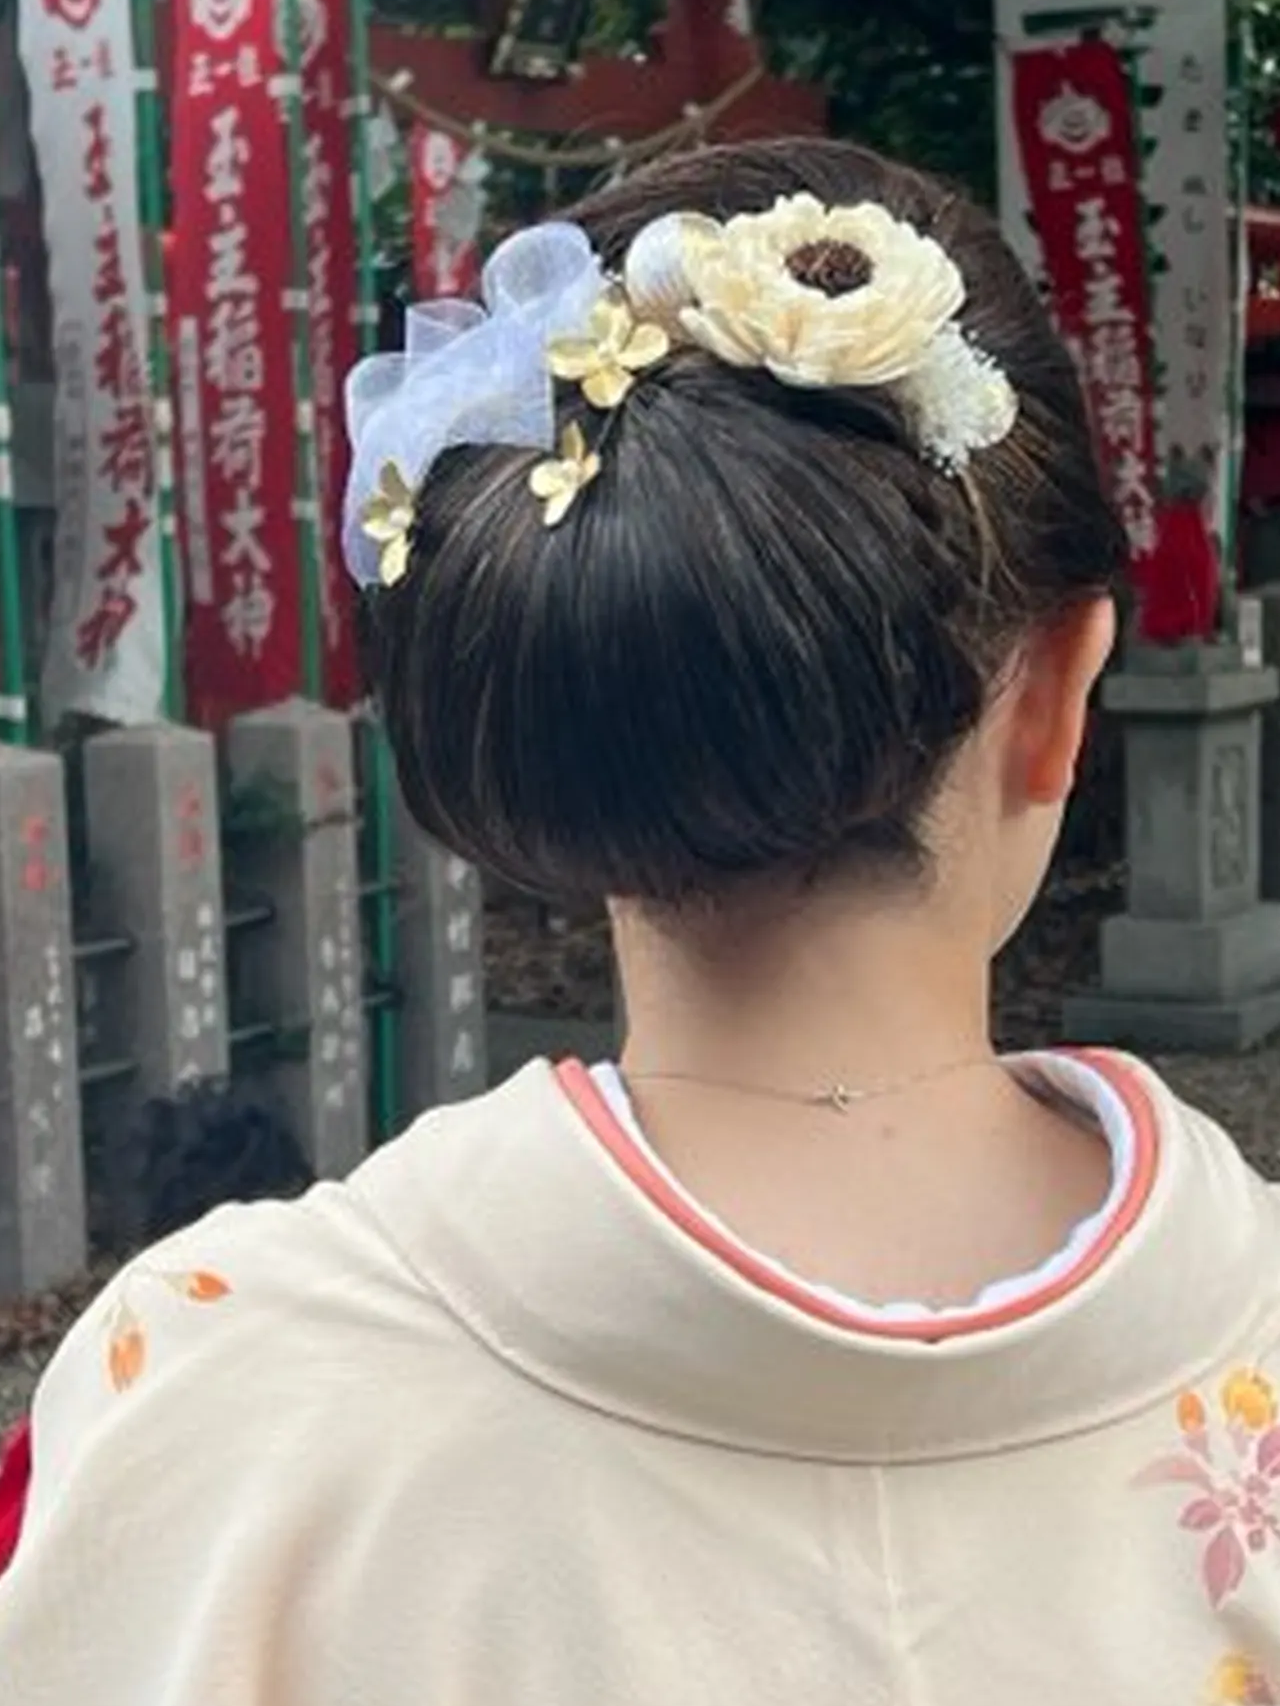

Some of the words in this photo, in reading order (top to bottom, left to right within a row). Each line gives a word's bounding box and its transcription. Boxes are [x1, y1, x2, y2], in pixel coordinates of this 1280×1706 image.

[204, 106, 276, 661] 玉主稲荷大神
